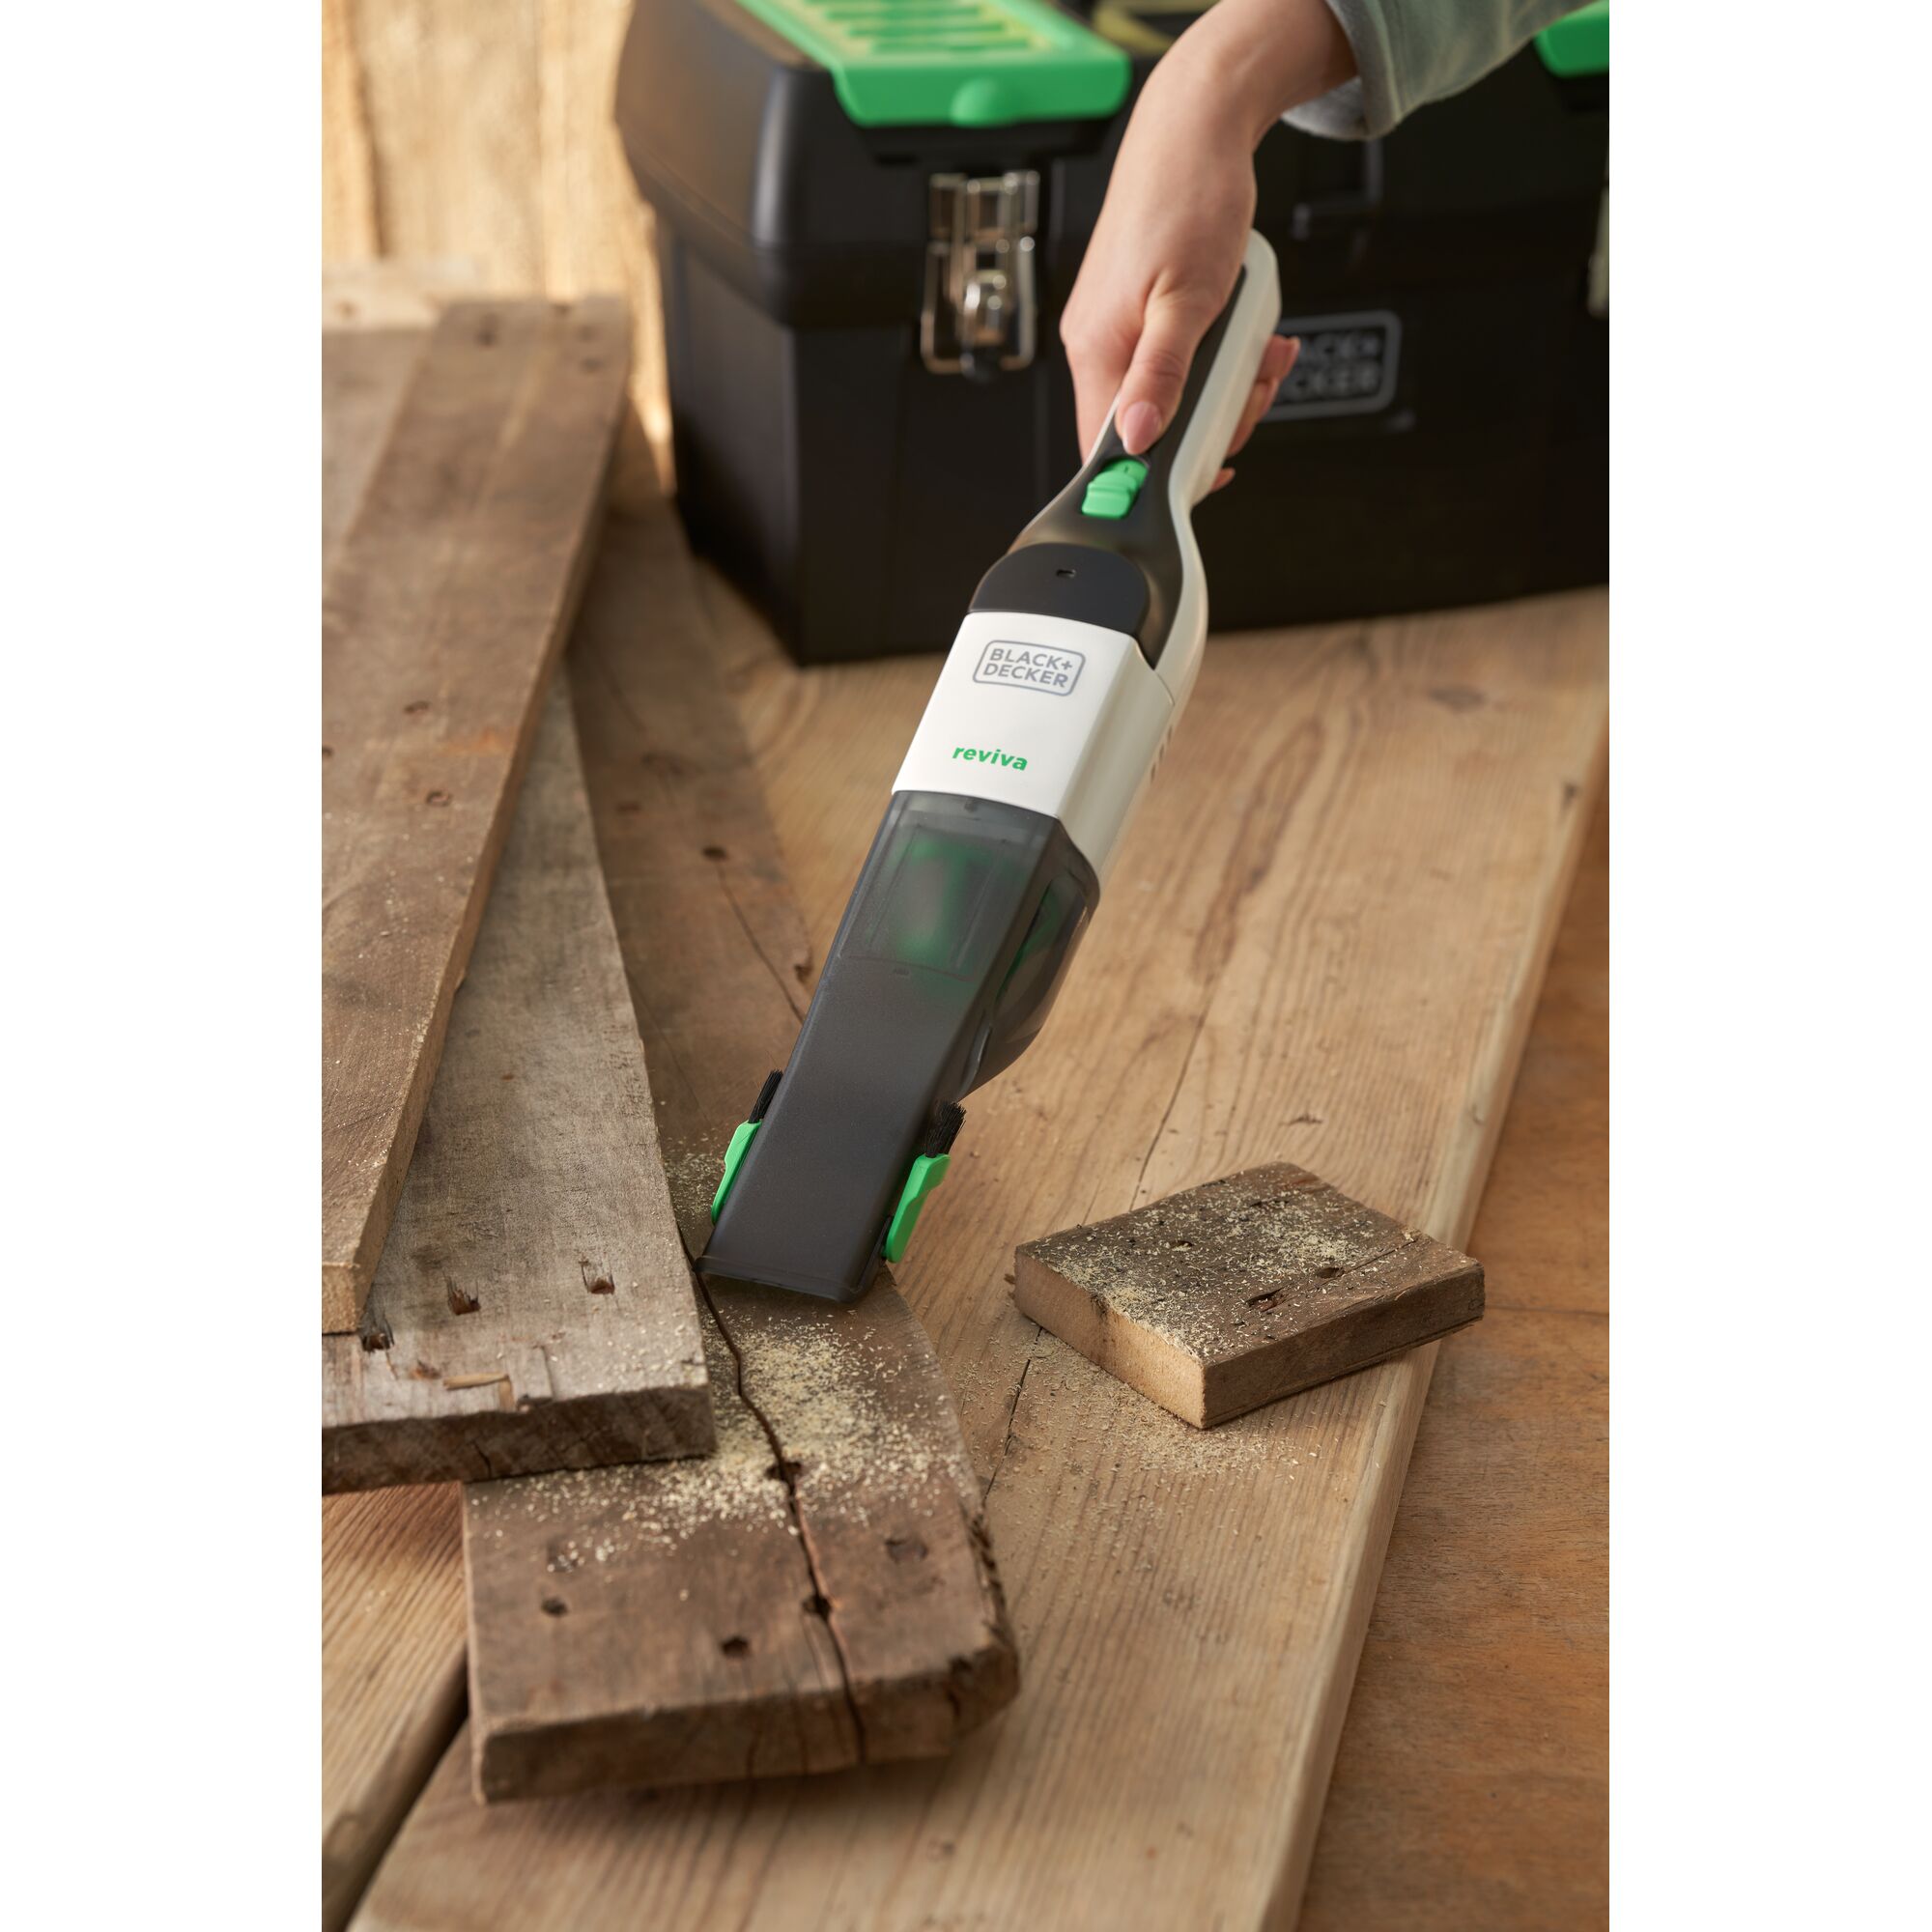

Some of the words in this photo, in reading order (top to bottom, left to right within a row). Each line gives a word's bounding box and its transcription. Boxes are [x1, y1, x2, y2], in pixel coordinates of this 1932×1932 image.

[990, 648, 1073, 670] BLACK+
[983, 663, 1068, 688] DECKER
[952, 747, 1028, 771] reviva
